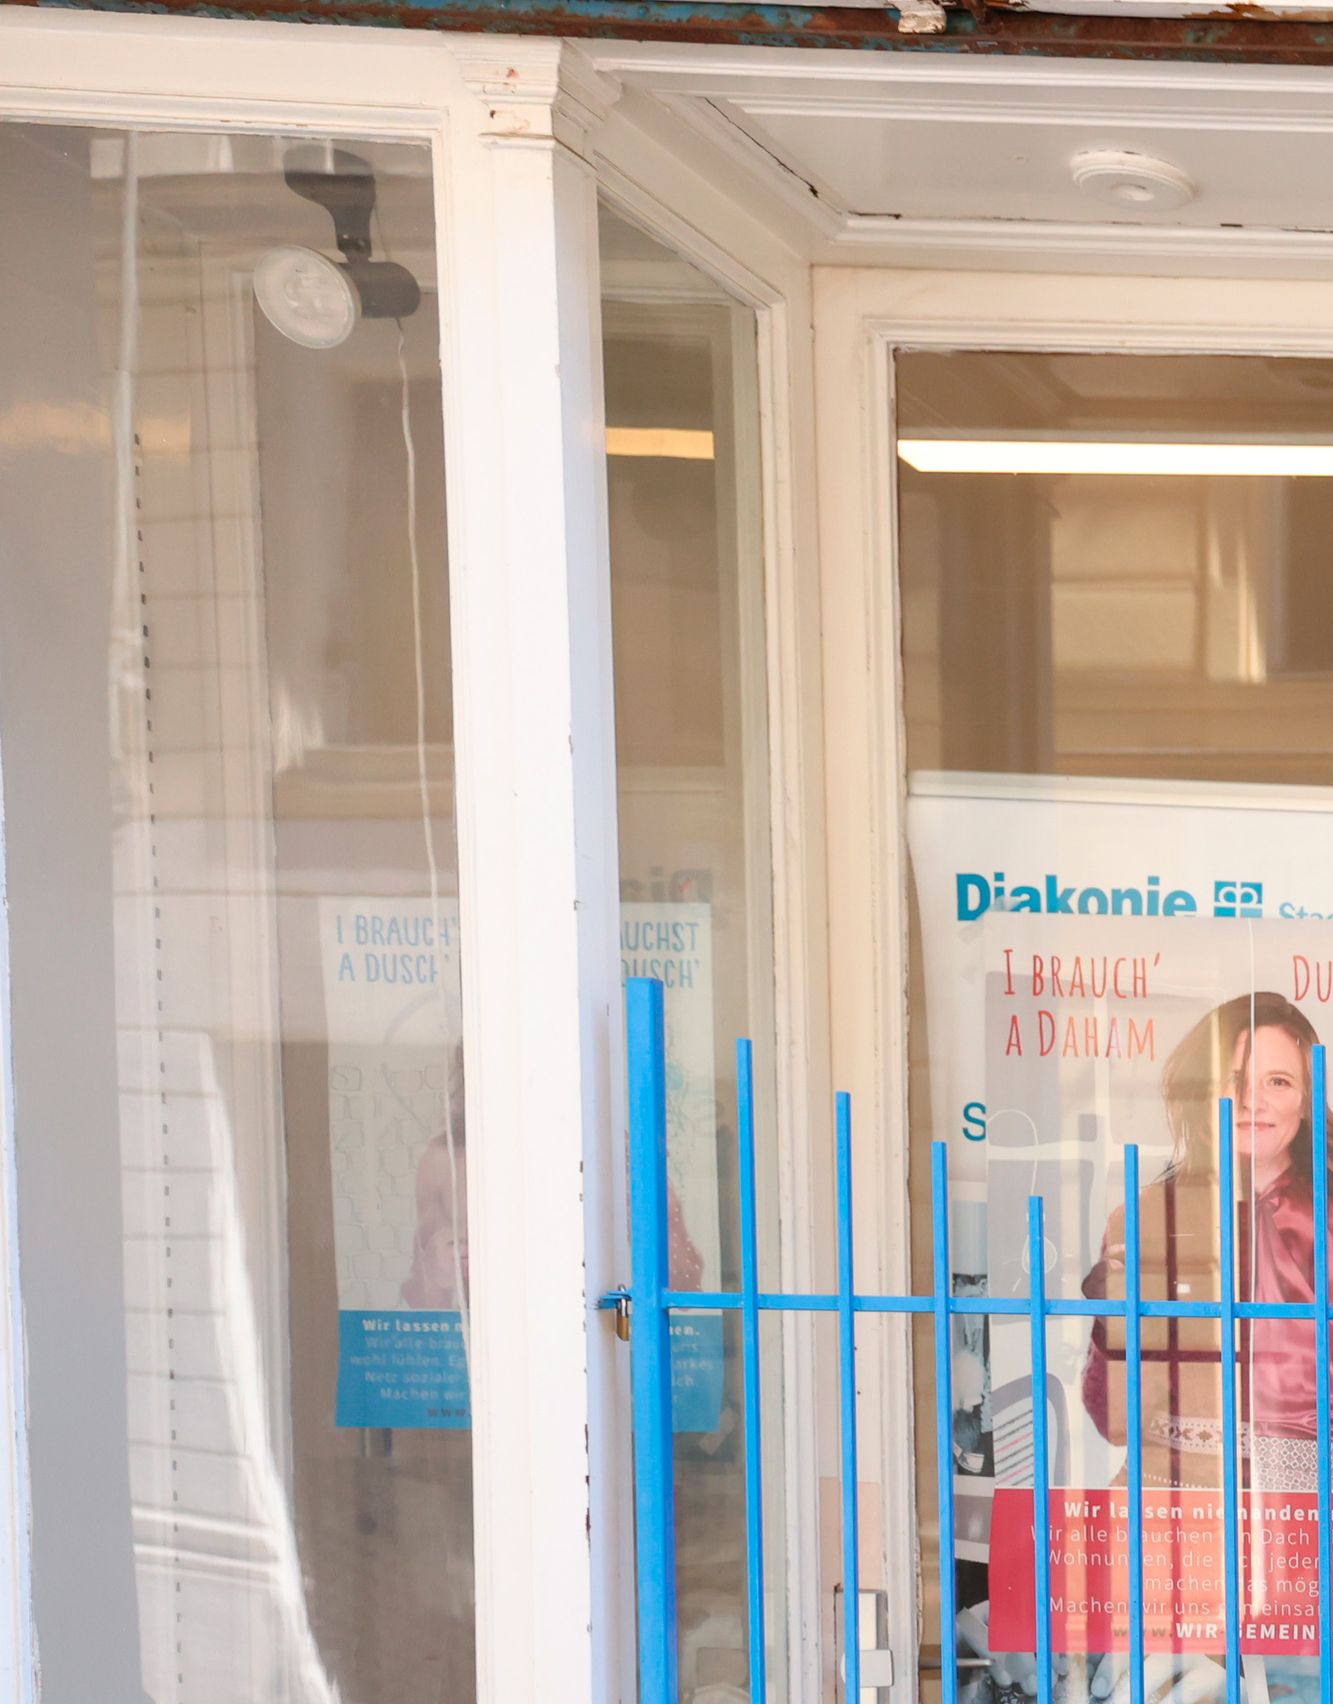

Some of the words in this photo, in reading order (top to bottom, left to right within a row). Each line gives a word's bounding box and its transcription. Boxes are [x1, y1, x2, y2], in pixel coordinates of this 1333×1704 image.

[956, 872, 1197, 921] Diakonie
[620, 921, 699, 952] UCHST
[1003, 949, 1015, 995] I
[1032, 952, 1160, 998] BRAUCH'
[1293, 955, 1333, 1003] DU
[1006, 1014, 1023, 1057] A
[1038, 1009, 1157, 1061] DAHAM
[362, 1319, 390, 1331] Wir
[395, 1319, 450, 1332] lassen
[1064, 1501, 1101, 1518] Wir
[1110, 1501, 1183, 1520] lasen
[1030, 1525, 1063, 1542] ir
[1070, 1526, 1108, 1543] alle
[1116, 1526, 1213, 1545] bauchen
[1049, 1550, 1174, 1571] Wohnunen,
[1182, 1551, 1213, 1568] die
[1144, 1576, 1224, 1593] machen
[1050, 1597, 1127, 1615] Machen
[1174, 1601, 1210, 1616] uns
